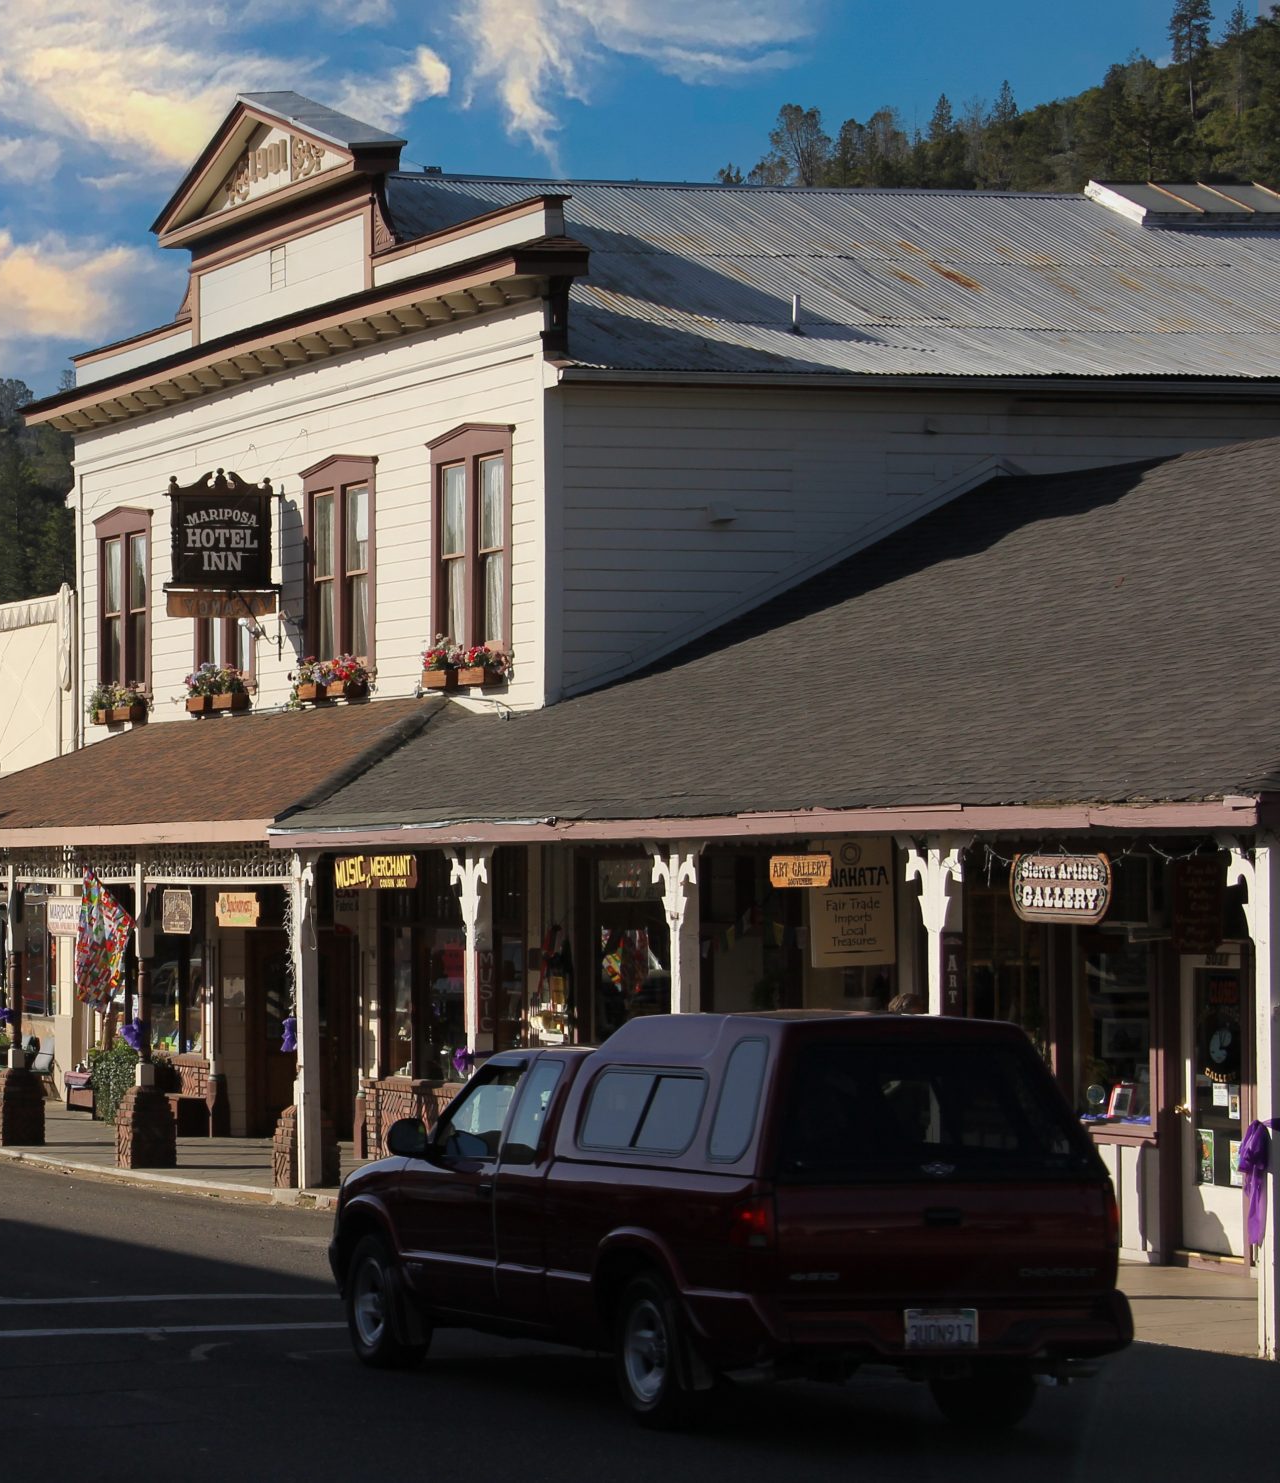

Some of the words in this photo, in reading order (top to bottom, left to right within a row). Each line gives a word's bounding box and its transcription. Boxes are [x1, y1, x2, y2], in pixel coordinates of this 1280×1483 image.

[249, 139, 288, 183] 1901
[186, 508, 260, 527] MARIPOSA
[186, 529, 259, 549] HOTEL
[202, 551, 243, 571] INN
[334, 855, 367, 889] MUSIC
[370, 854, 412, 877] MERCHANT
[772, 861, 789, 878] ART
[792, 860, 827, 878] GALLERY
[1021, 861, 1057, 880] Sierra
[1058, 862, 1099, 881] Artists
[395, 878, 408, 888] JACK
[826, 900, 846, 912] Fair
[849, 897, 881, 911] Trade
[1022, 885, 1097, 910] GALLERY
[834, 913, 872, 926] Imports
[841, 923, 867, 937] Local
[831, 935, 877, 948] Treasures
[947, 954, 958, 1004] ART
[480, 952, 494, 1033] MUSIC
